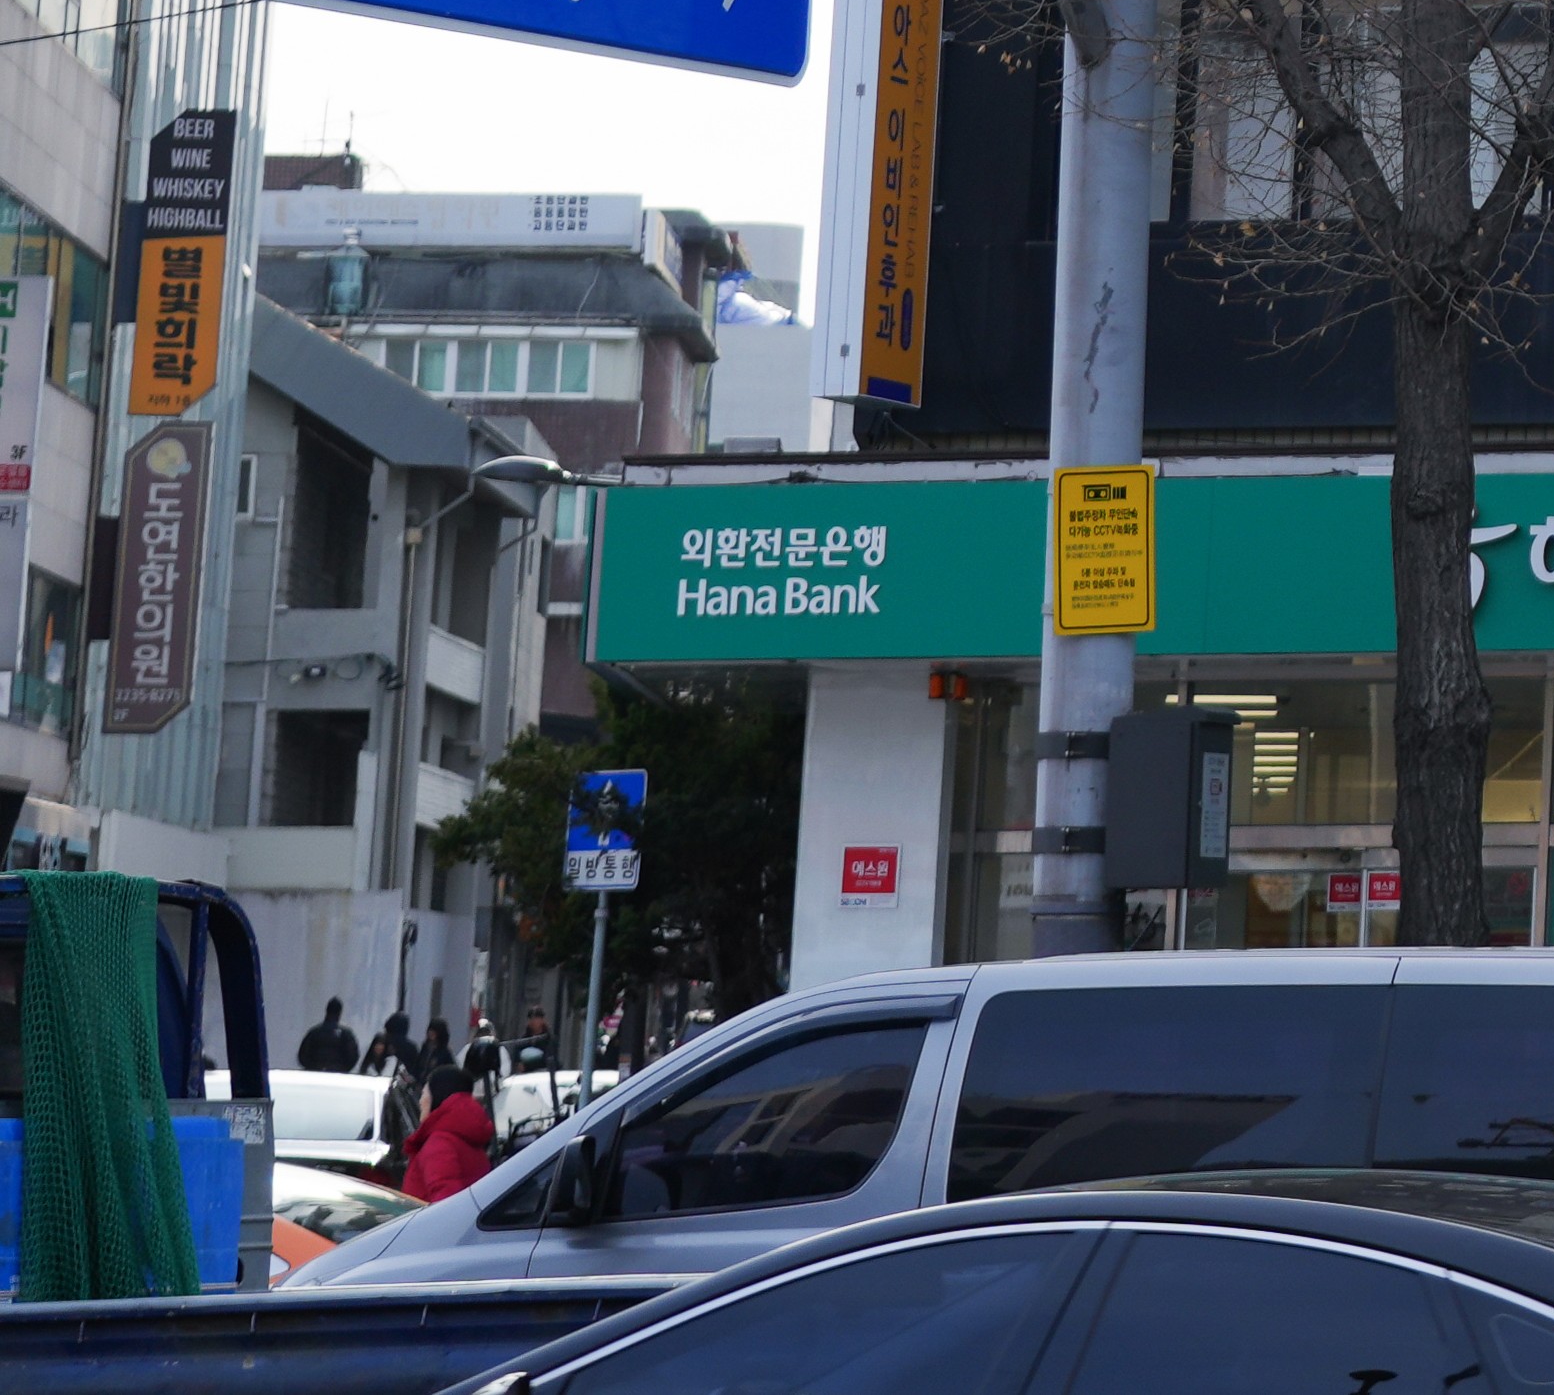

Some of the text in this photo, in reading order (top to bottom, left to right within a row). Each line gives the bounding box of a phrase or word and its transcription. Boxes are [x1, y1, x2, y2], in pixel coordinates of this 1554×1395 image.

[172, 117, 215, 140] BEER
[171, 148, 211, 170] WINE
[153, 178, 225, 201] WHISKEY
[146, 207, 225, 231] HIGHBALL
[876, 111, 903, 349] 이비인후과
[681, 525, 888, 570] 외환전문은행
[677, 574, 881, 618] Hana Bank
[852, 860, 889, 878] 에스원
